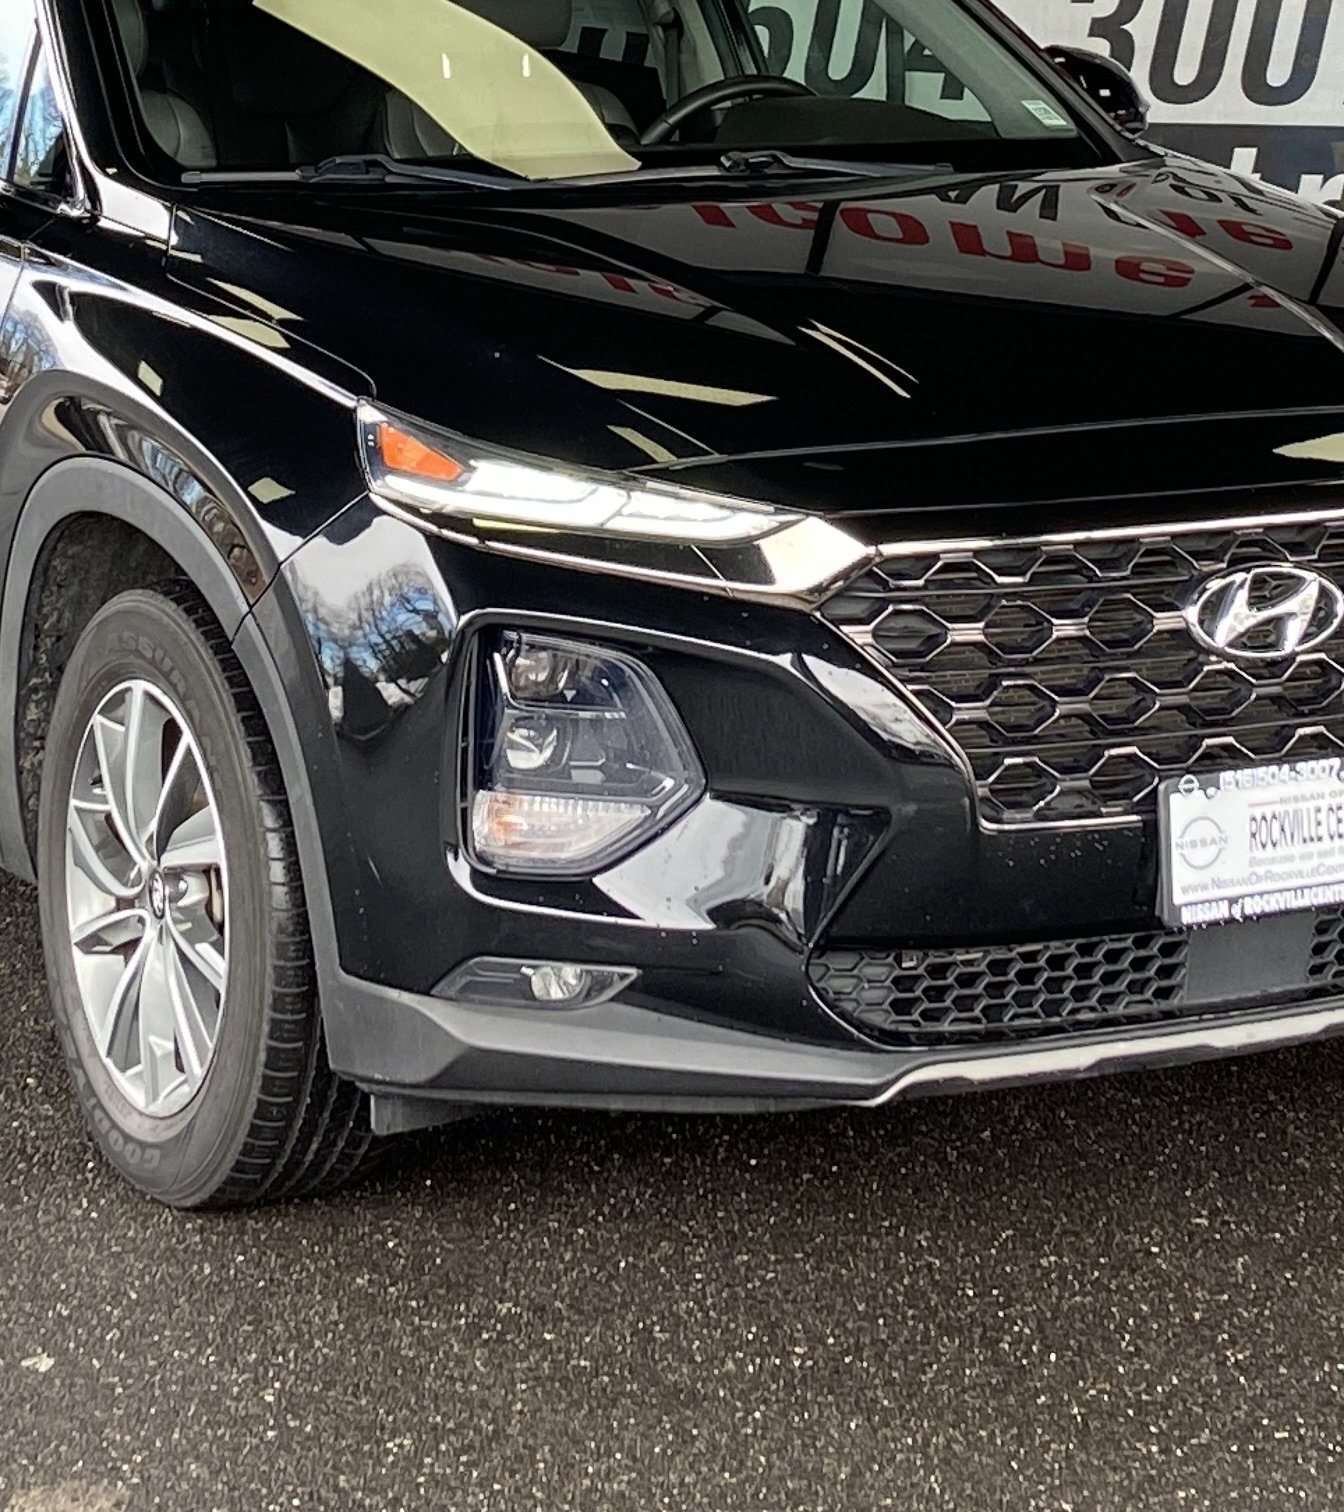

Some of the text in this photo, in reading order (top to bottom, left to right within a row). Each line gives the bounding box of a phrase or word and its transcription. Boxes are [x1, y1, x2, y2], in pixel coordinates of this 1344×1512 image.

[1279, 792, 1326, 806] NISSAN
[1249, 805, 1324, 853] ROCKVILLE
[1175, 835, 1229, 851] NISSAN
